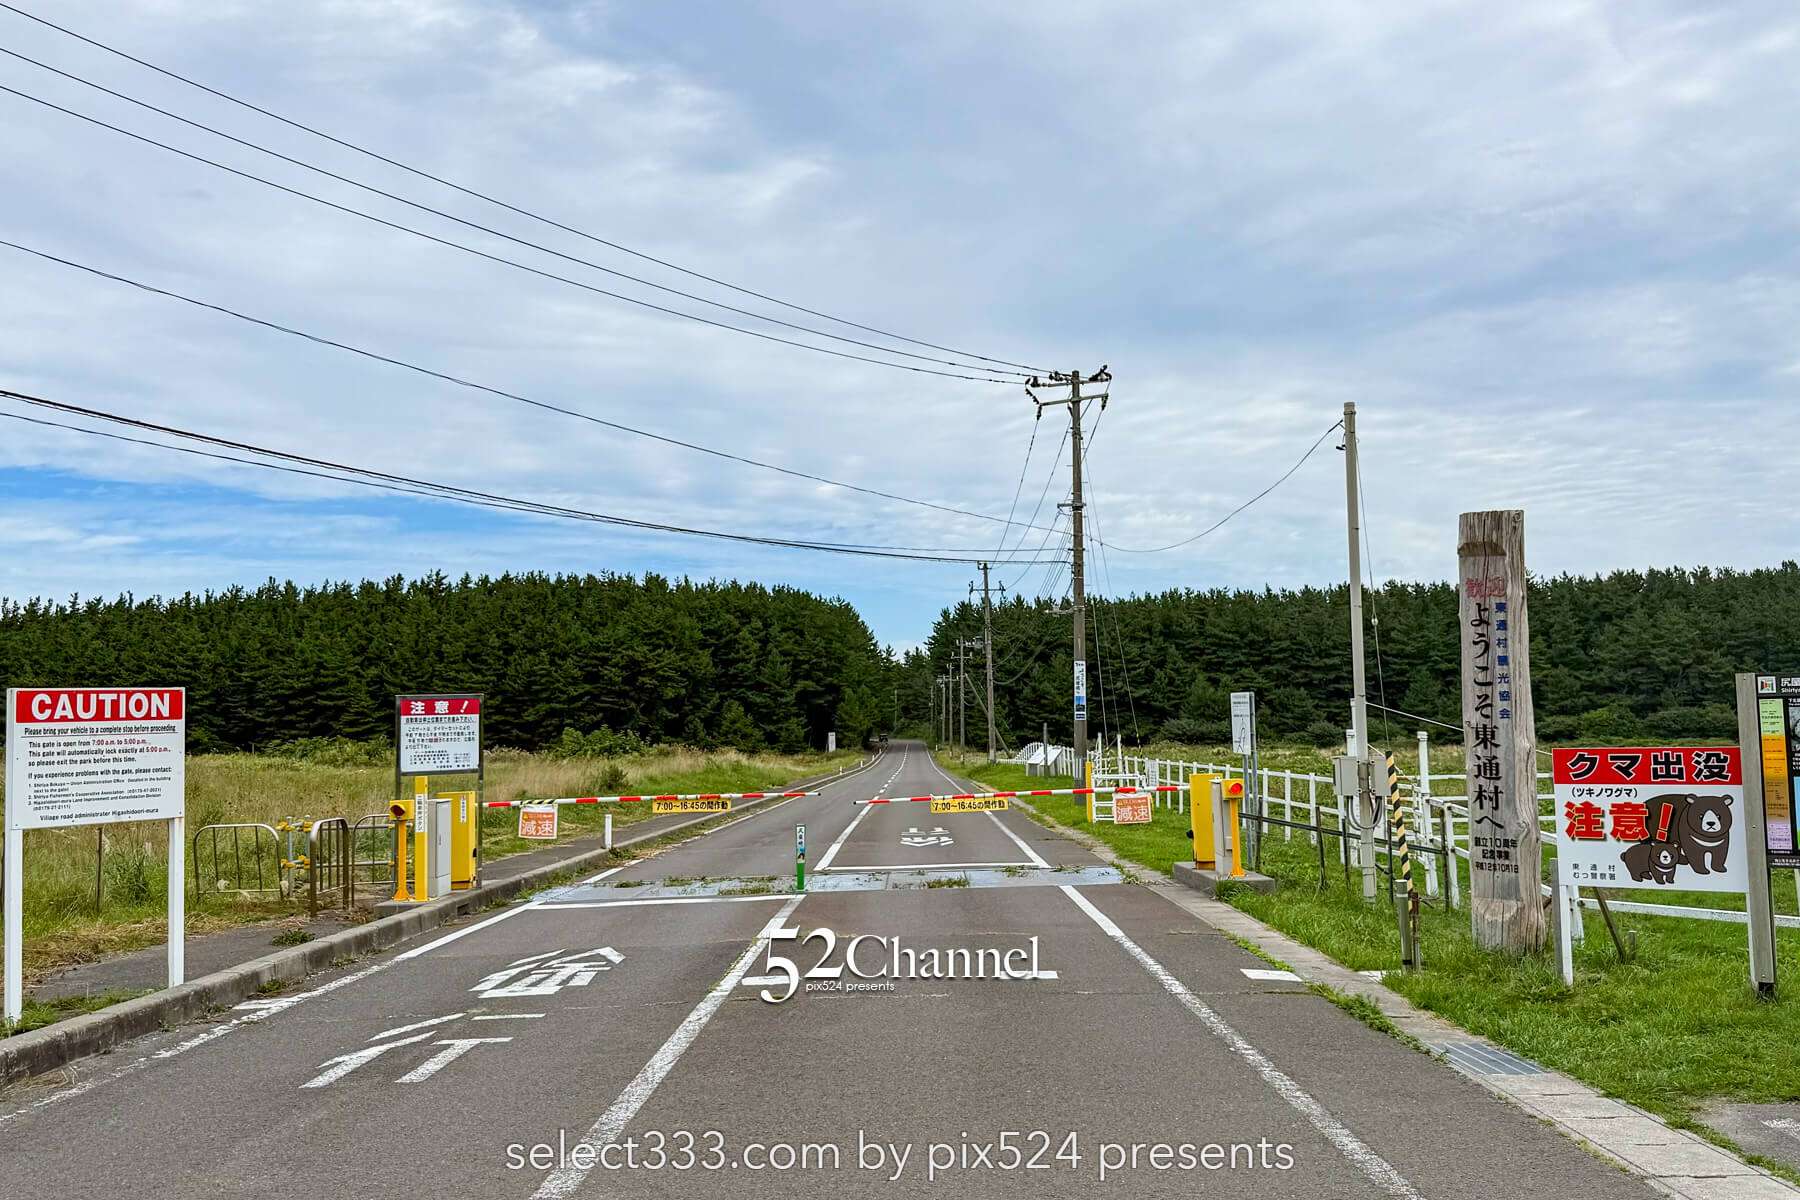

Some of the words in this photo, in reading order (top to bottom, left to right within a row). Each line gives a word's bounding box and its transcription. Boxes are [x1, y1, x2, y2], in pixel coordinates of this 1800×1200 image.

[1494, 602, 1512, 719] 東通村観光協会
[31, 693, 170, 720] CAUTION
[1470, 602, 1504, 829] ようこそ東通村へ
[1566, 751, 1732, 781] クマ出没
[1116, 805, 1149, 821] 減速
[521, 819, 553, 836] 減速
